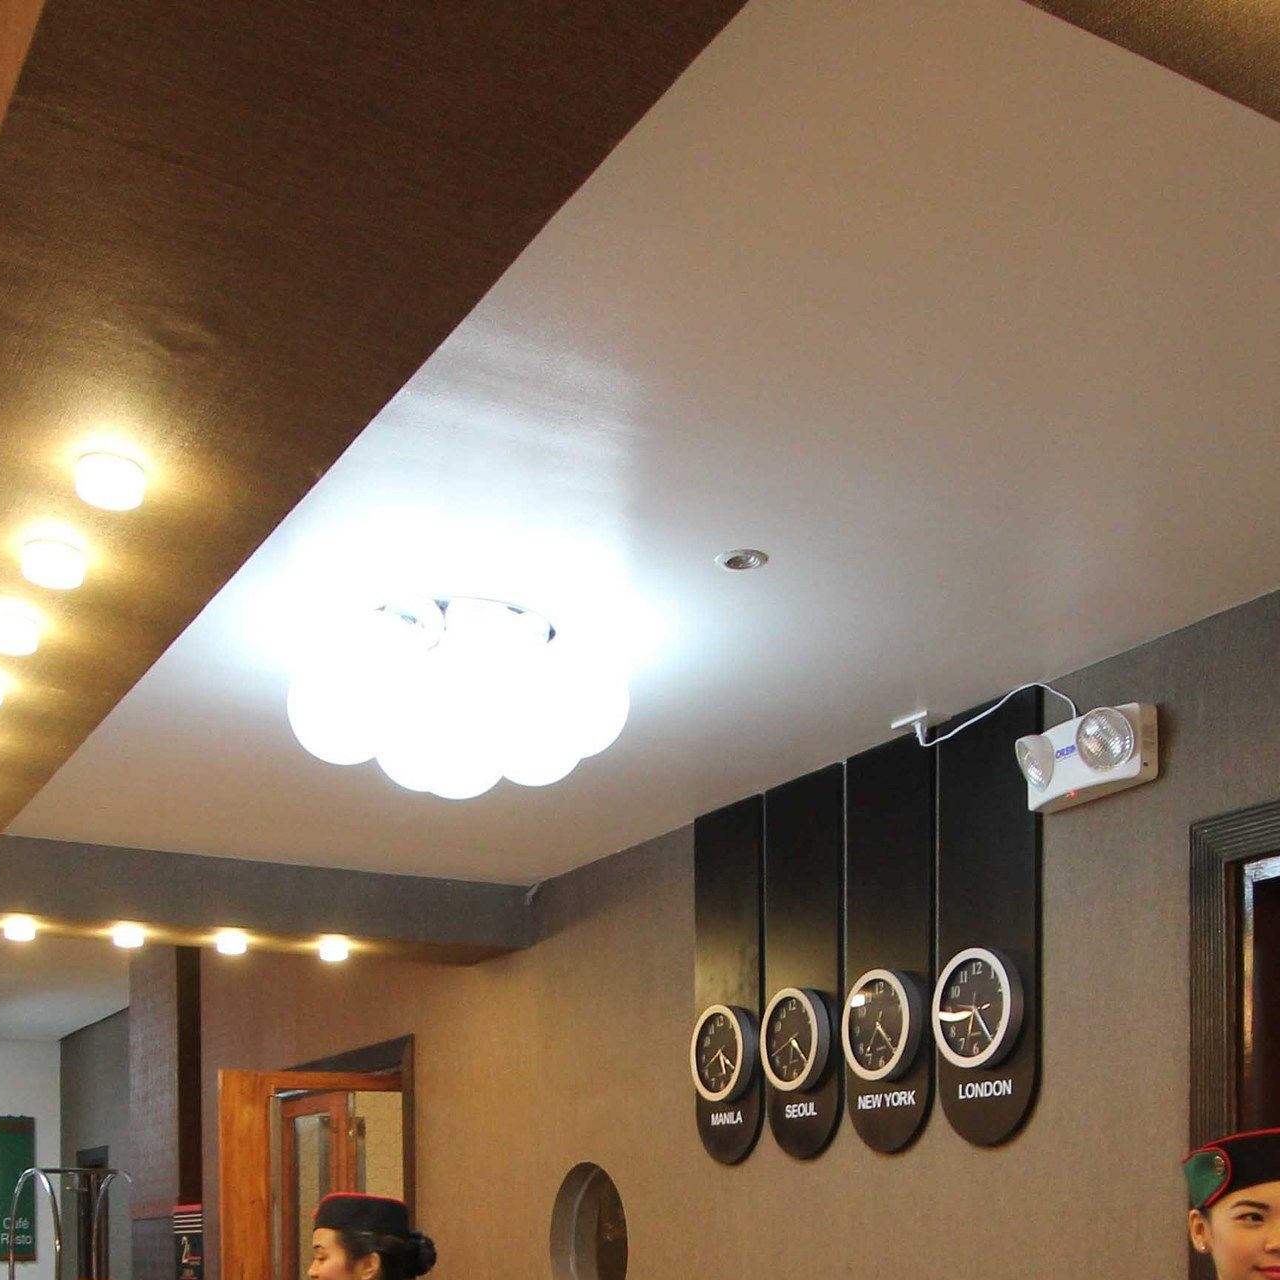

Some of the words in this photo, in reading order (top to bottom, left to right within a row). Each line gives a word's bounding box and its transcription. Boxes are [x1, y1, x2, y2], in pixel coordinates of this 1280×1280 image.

[972, 961, 983, 975] 12
[959, 970, 968, 984] 11
[950, 985, 961, 999] 10
[958, 1079, 1013, 1100] LONDON
[857, 1092, 883, 1110] NEW
[883, 1090, 916, 1108] YORK
[711, 1110, 743, 1126] MANILA
[785, 1102, 817, 1119] SEOUL
[0, 1232, 32, 1245] Rsto
